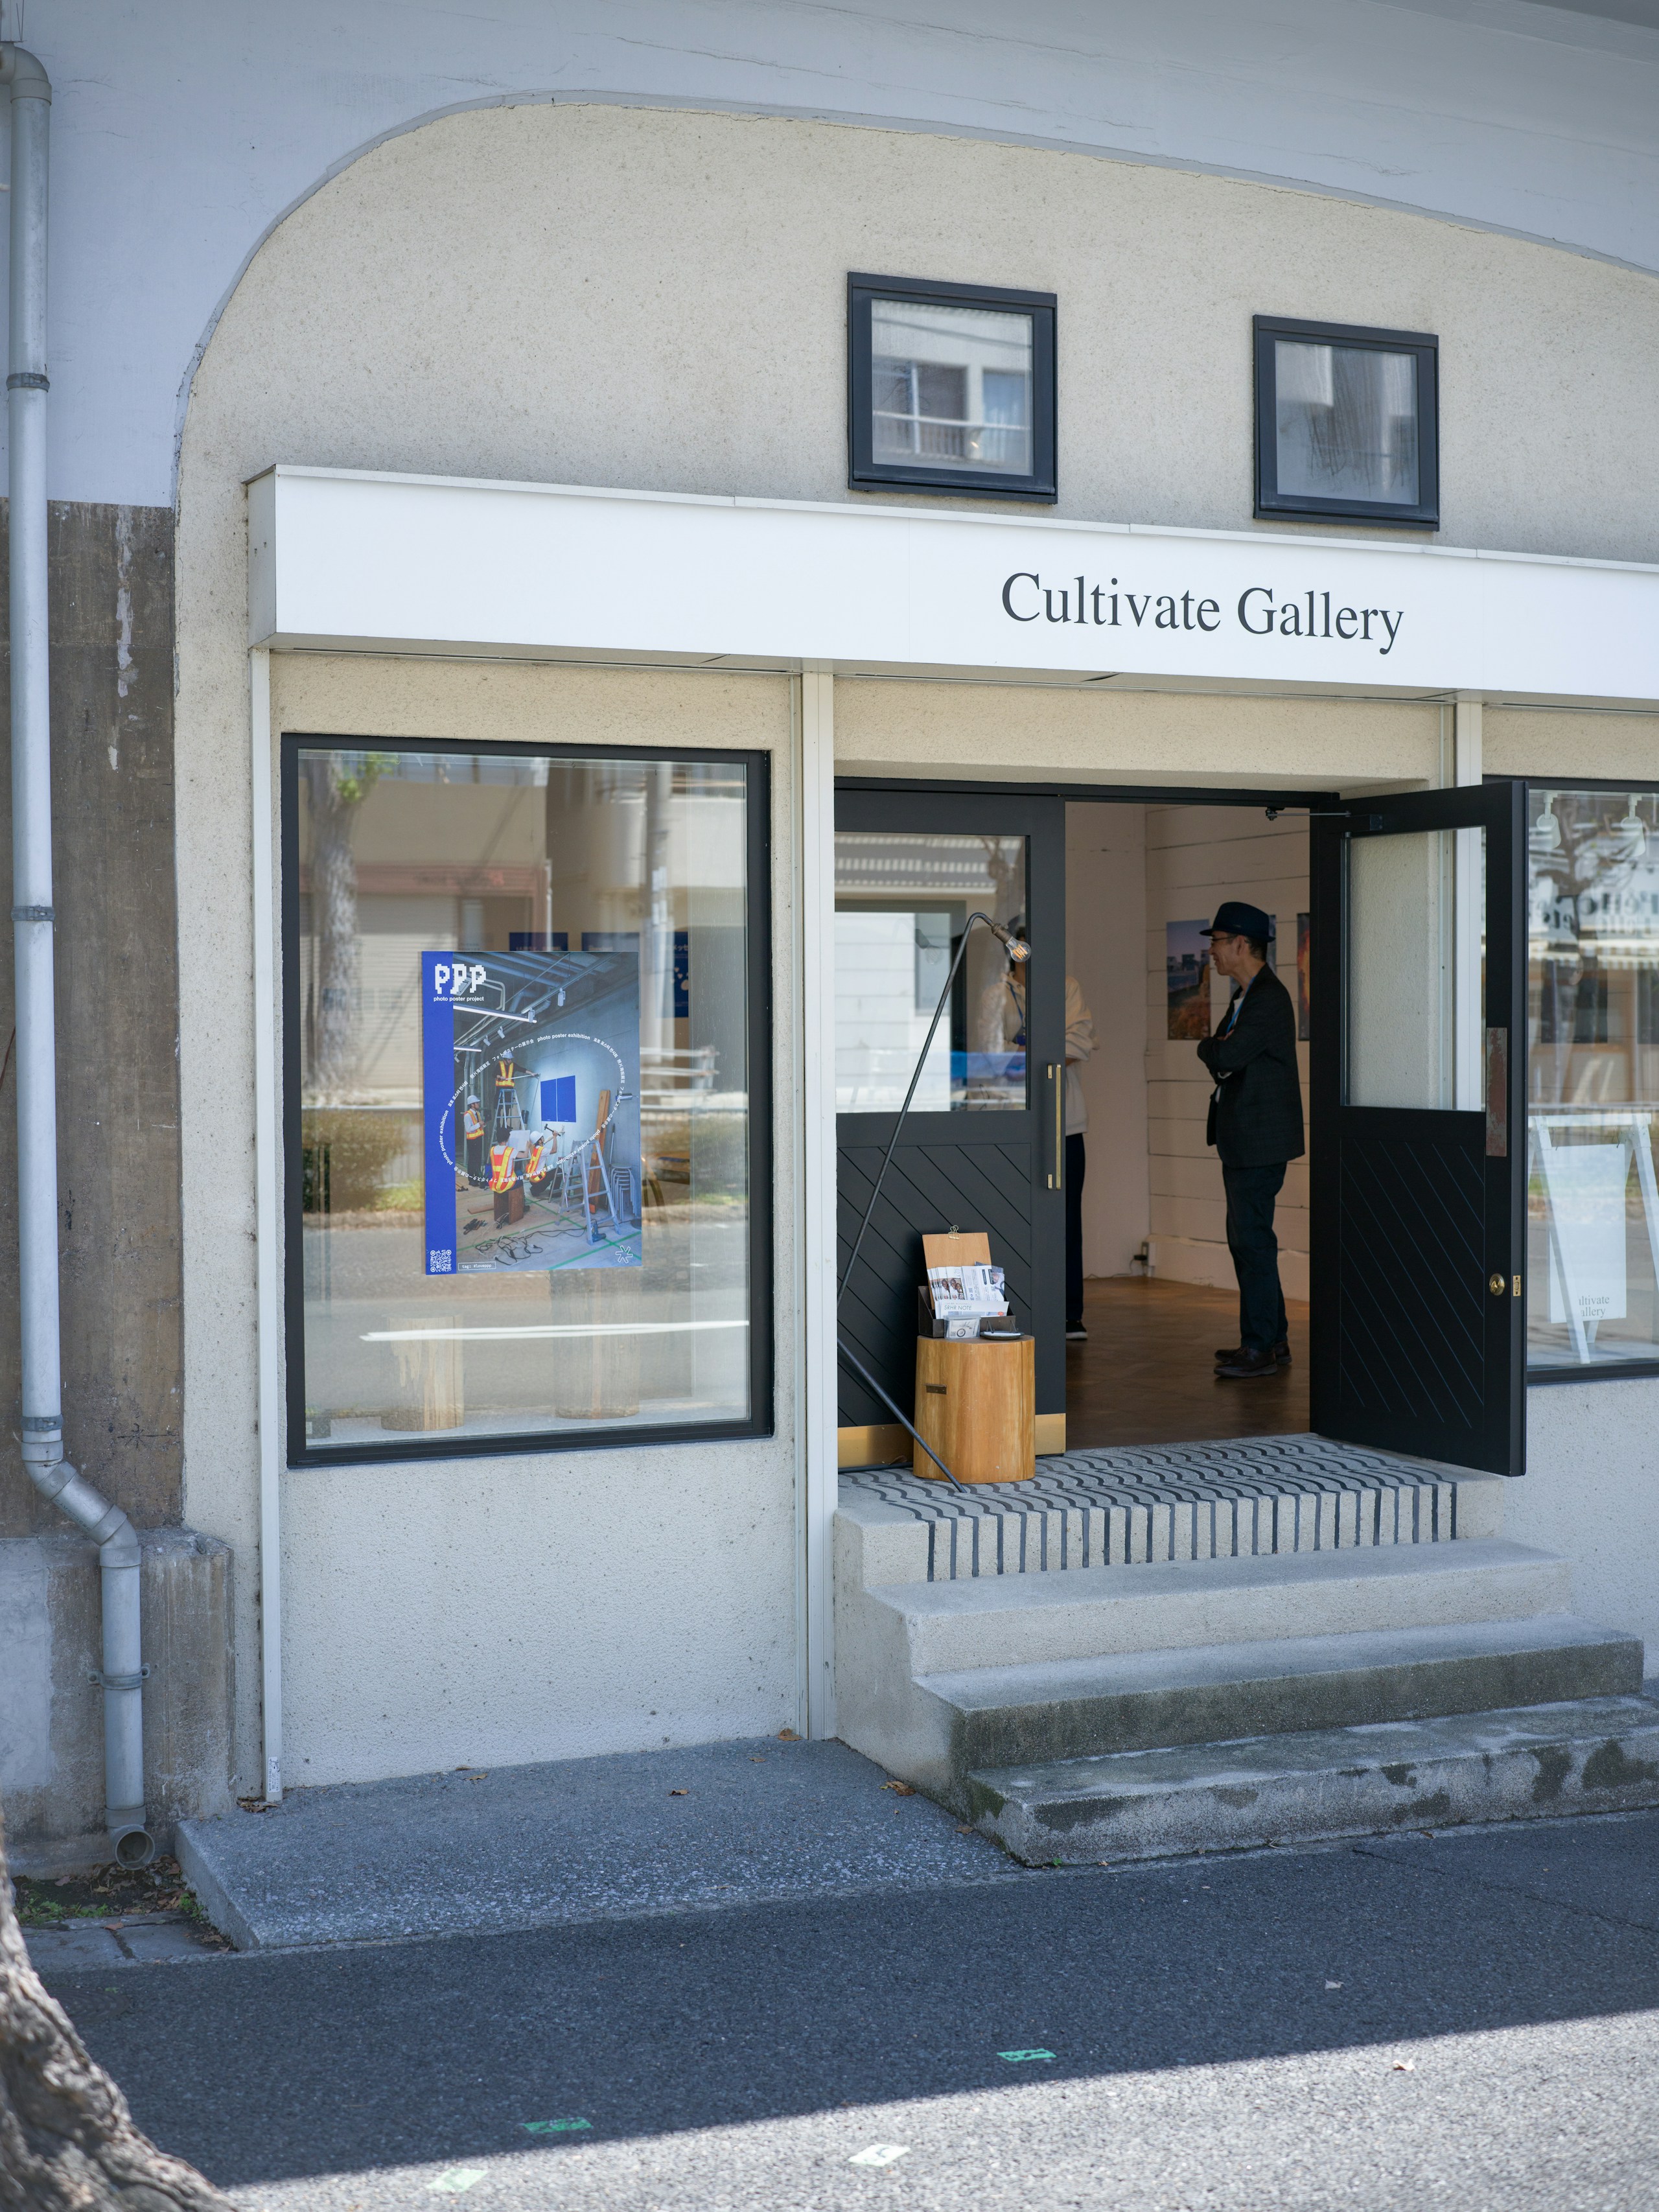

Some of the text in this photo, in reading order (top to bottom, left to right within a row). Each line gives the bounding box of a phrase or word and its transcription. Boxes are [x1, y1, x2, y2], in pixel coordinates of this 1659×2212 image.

[1001, 572, 1405, 655] Cultivate Gallery
[435, 964, 487, 994] PPP
[439, 1110, 448, 1134] exhibition
[443, 1152, 453, 1165] photo
[556, 1129, 601, 1165] photo poster exhibition
[1581, 1307, 1606, 1318] allery
